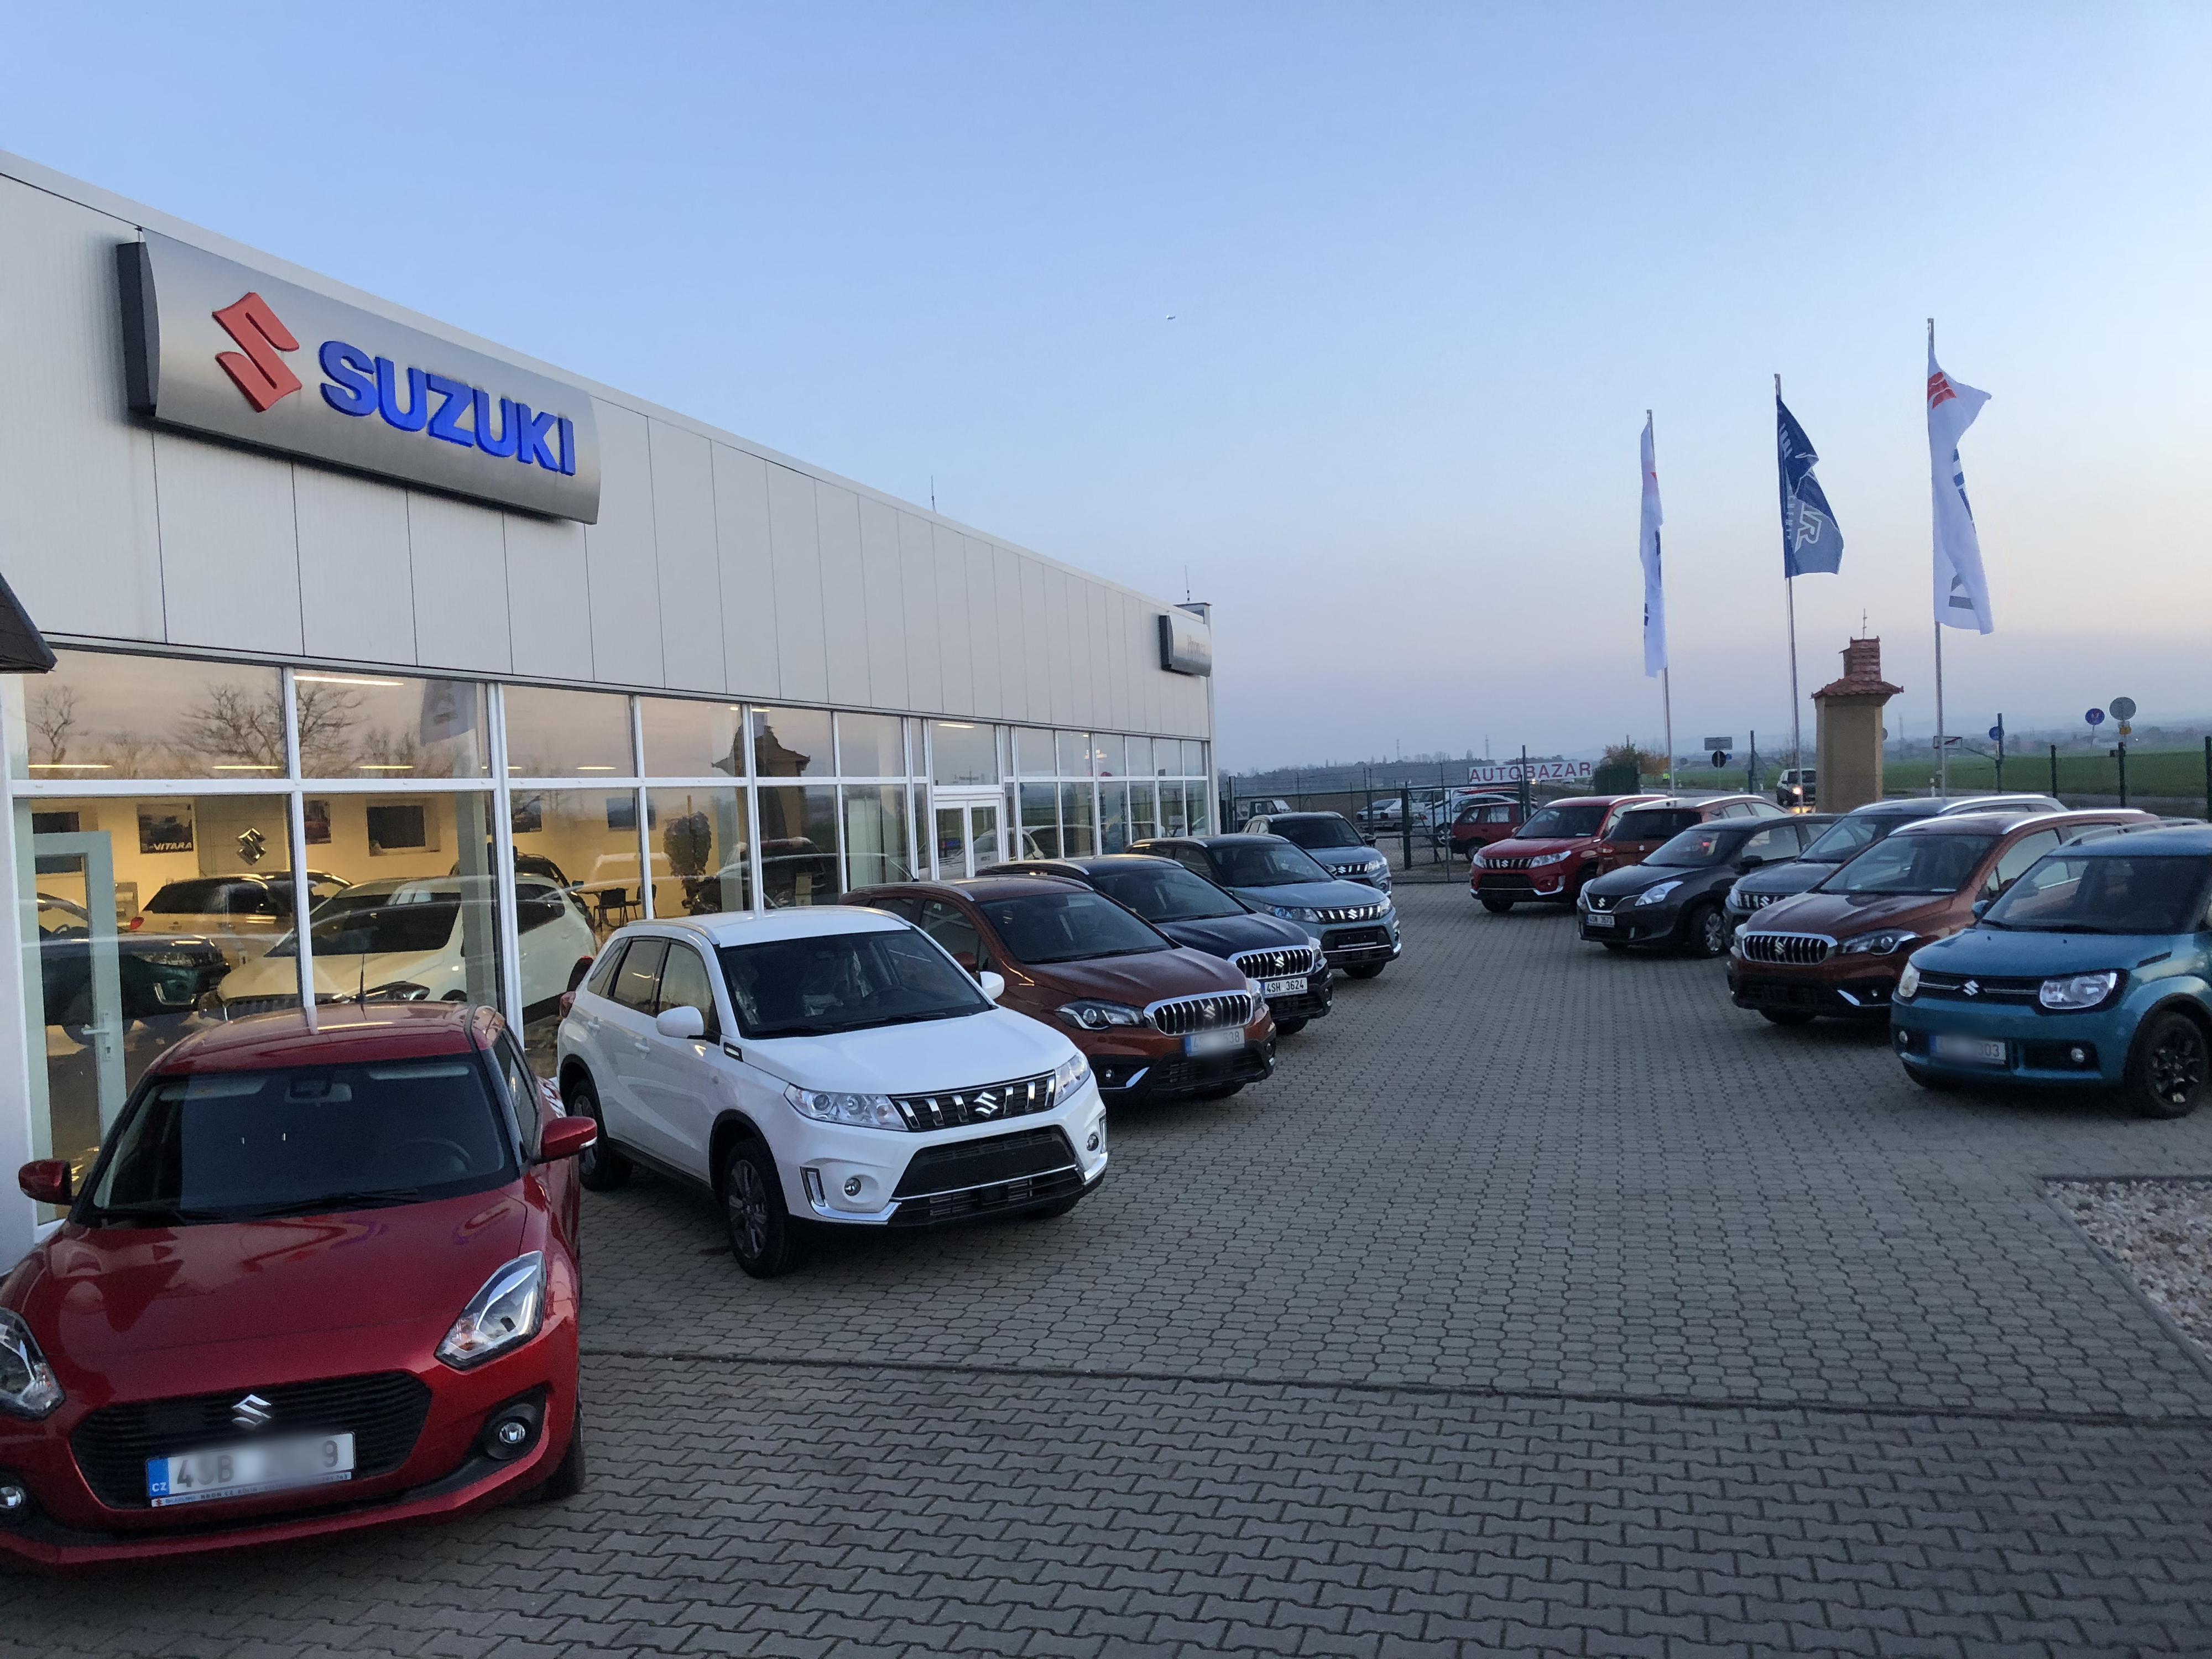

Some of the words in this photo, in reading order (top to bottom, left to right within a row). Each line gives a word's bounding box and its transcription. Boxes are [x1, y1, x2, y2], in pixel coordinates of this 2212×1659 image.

[319, 341, 576, 476] SUZUKI
[1469, 762, 1591, 782] AUTOBAZAR
[1266, 982, 1281, 993] 4SH
[1286, 979, 1304, 991] 3624
[152, 1481, 166, 1492] CZ
